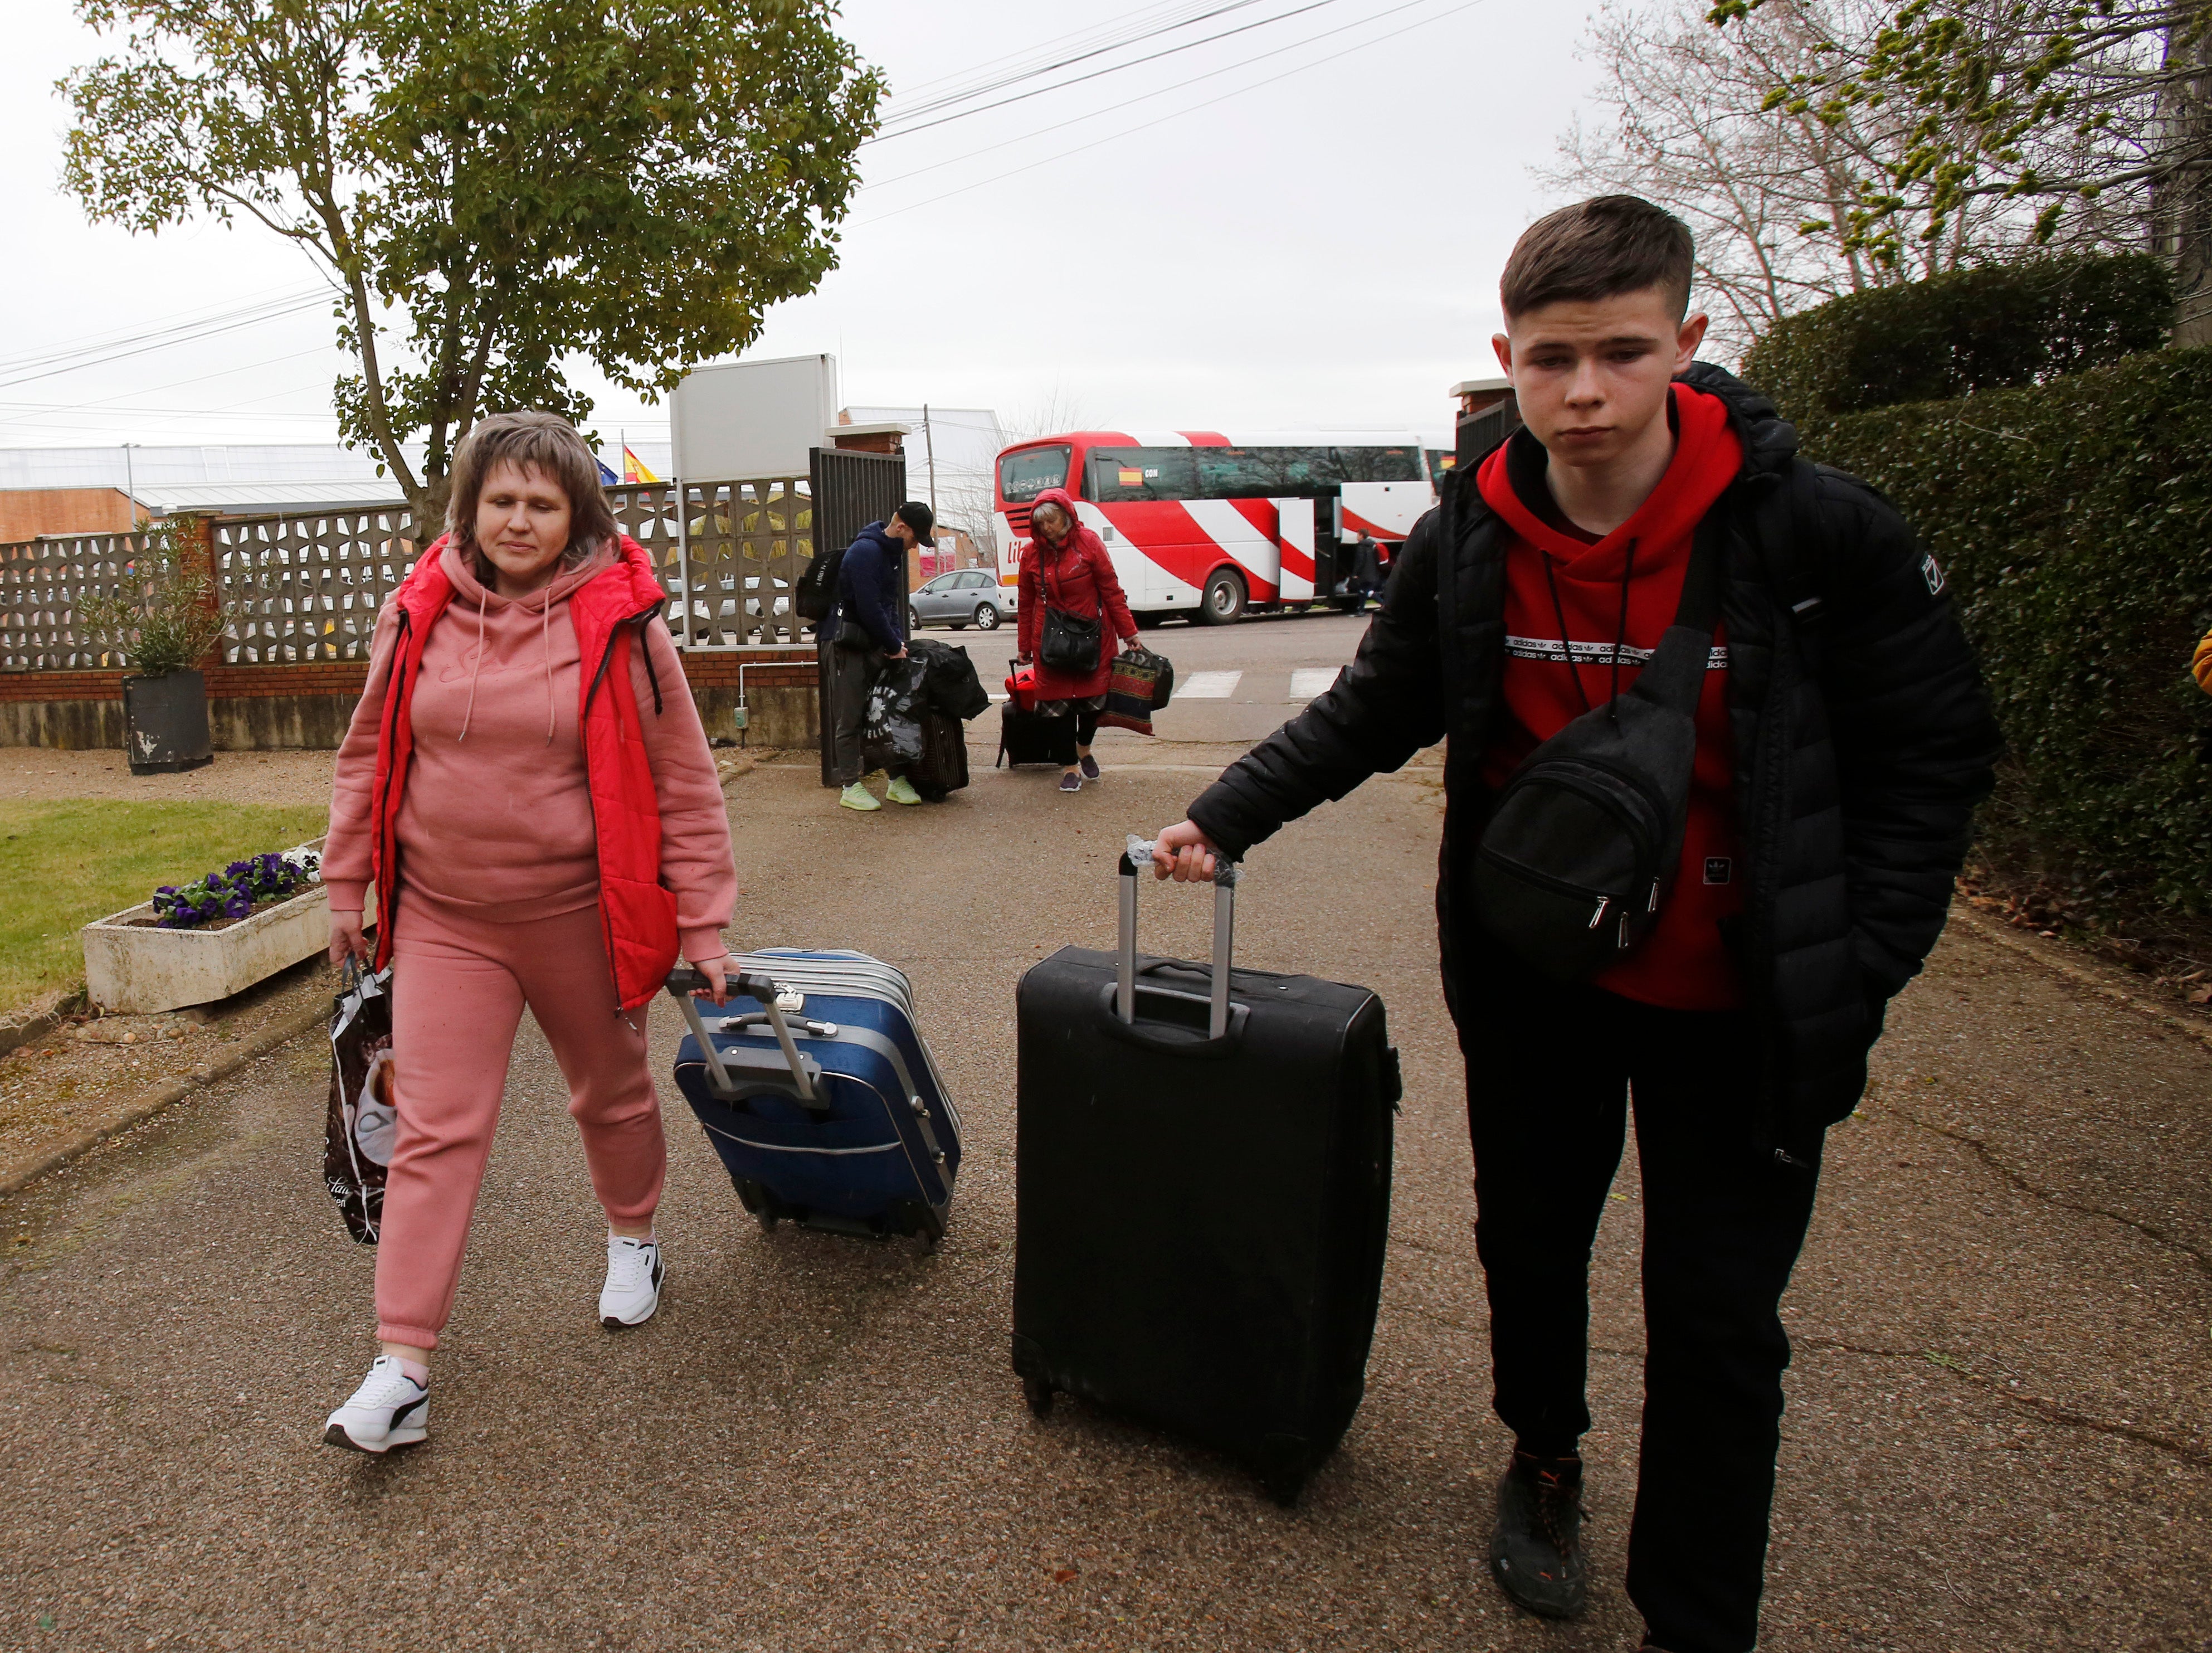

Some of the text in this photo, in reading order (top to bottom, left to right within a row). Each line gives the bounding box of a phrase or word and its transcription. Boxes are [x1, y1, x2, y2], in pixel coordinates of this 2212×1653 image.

[1144, 469, 1158, 478] CON
[1513, 639, 1537, 648] adidas
[1513, 650, 1537, 658] adidas
